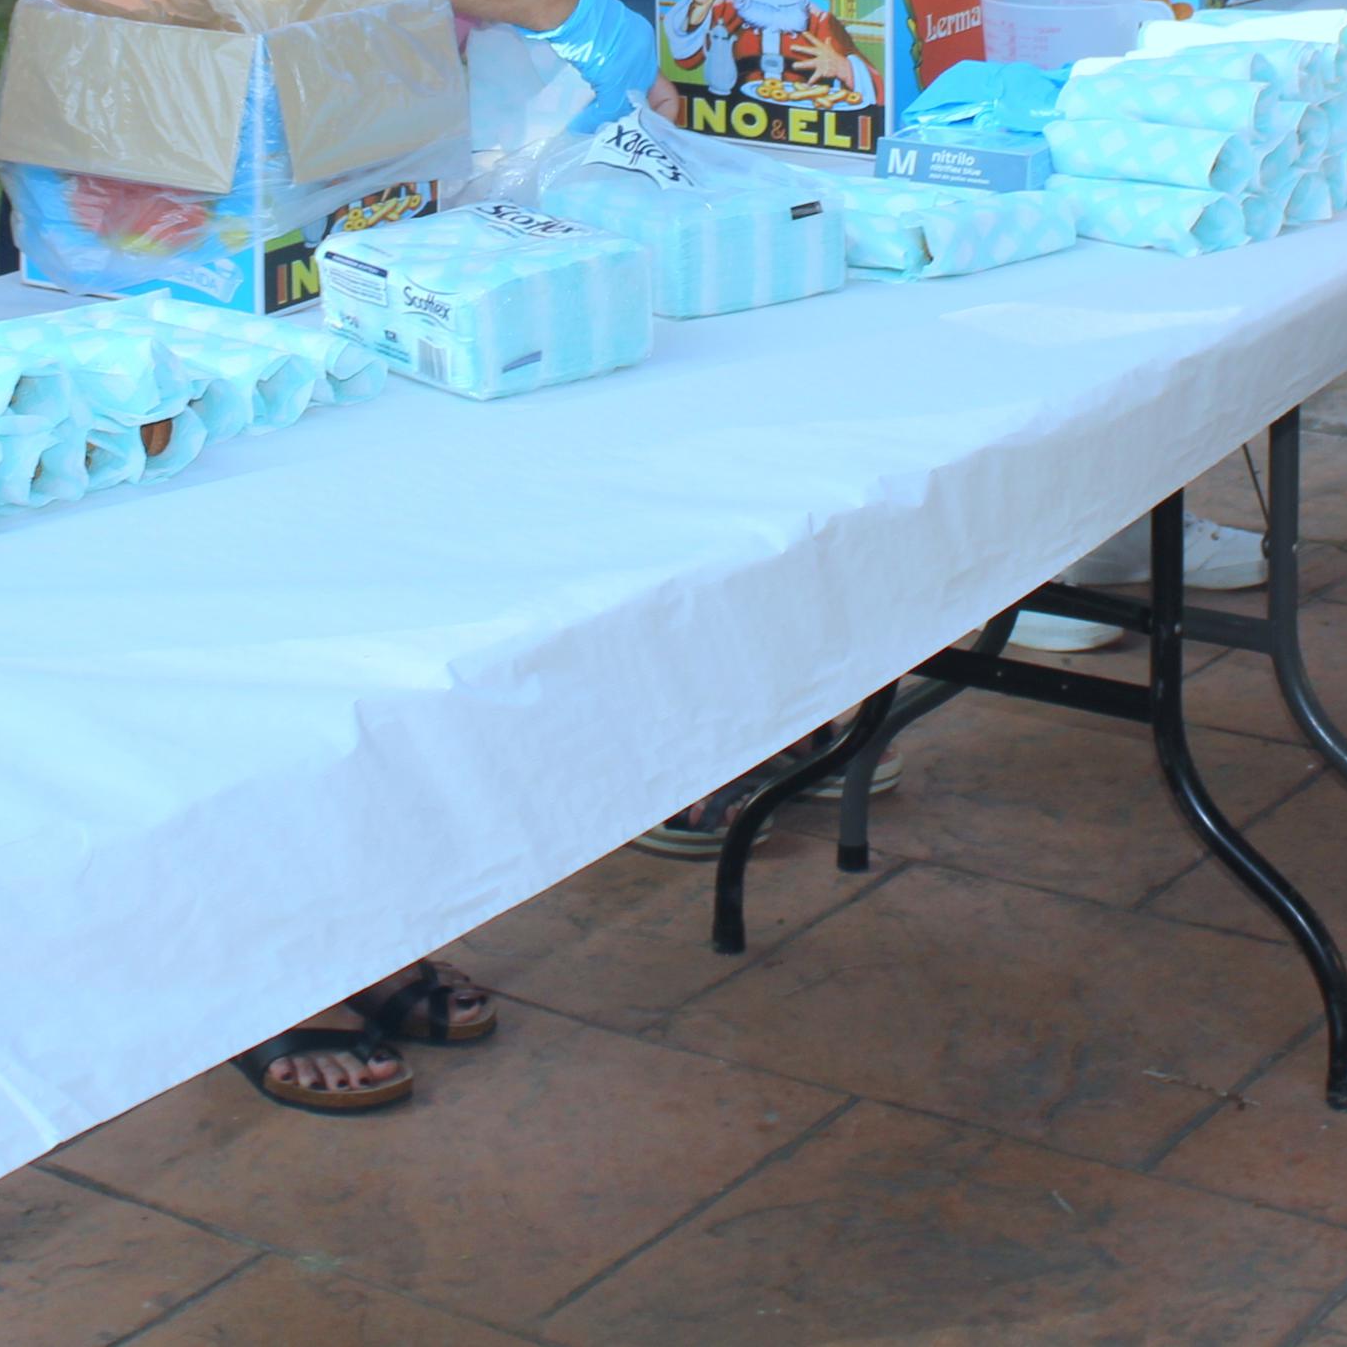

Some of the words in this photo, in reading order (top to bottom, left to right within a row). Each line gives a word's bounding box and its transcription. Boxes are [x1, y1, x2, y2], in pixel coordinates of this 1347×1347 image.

[925, 5, 981, 43] Lerma
[887, 147, 918, 176] M
[931, 150, 975, 166] nitrilo
[404, 286, 450, 321] Scottex
